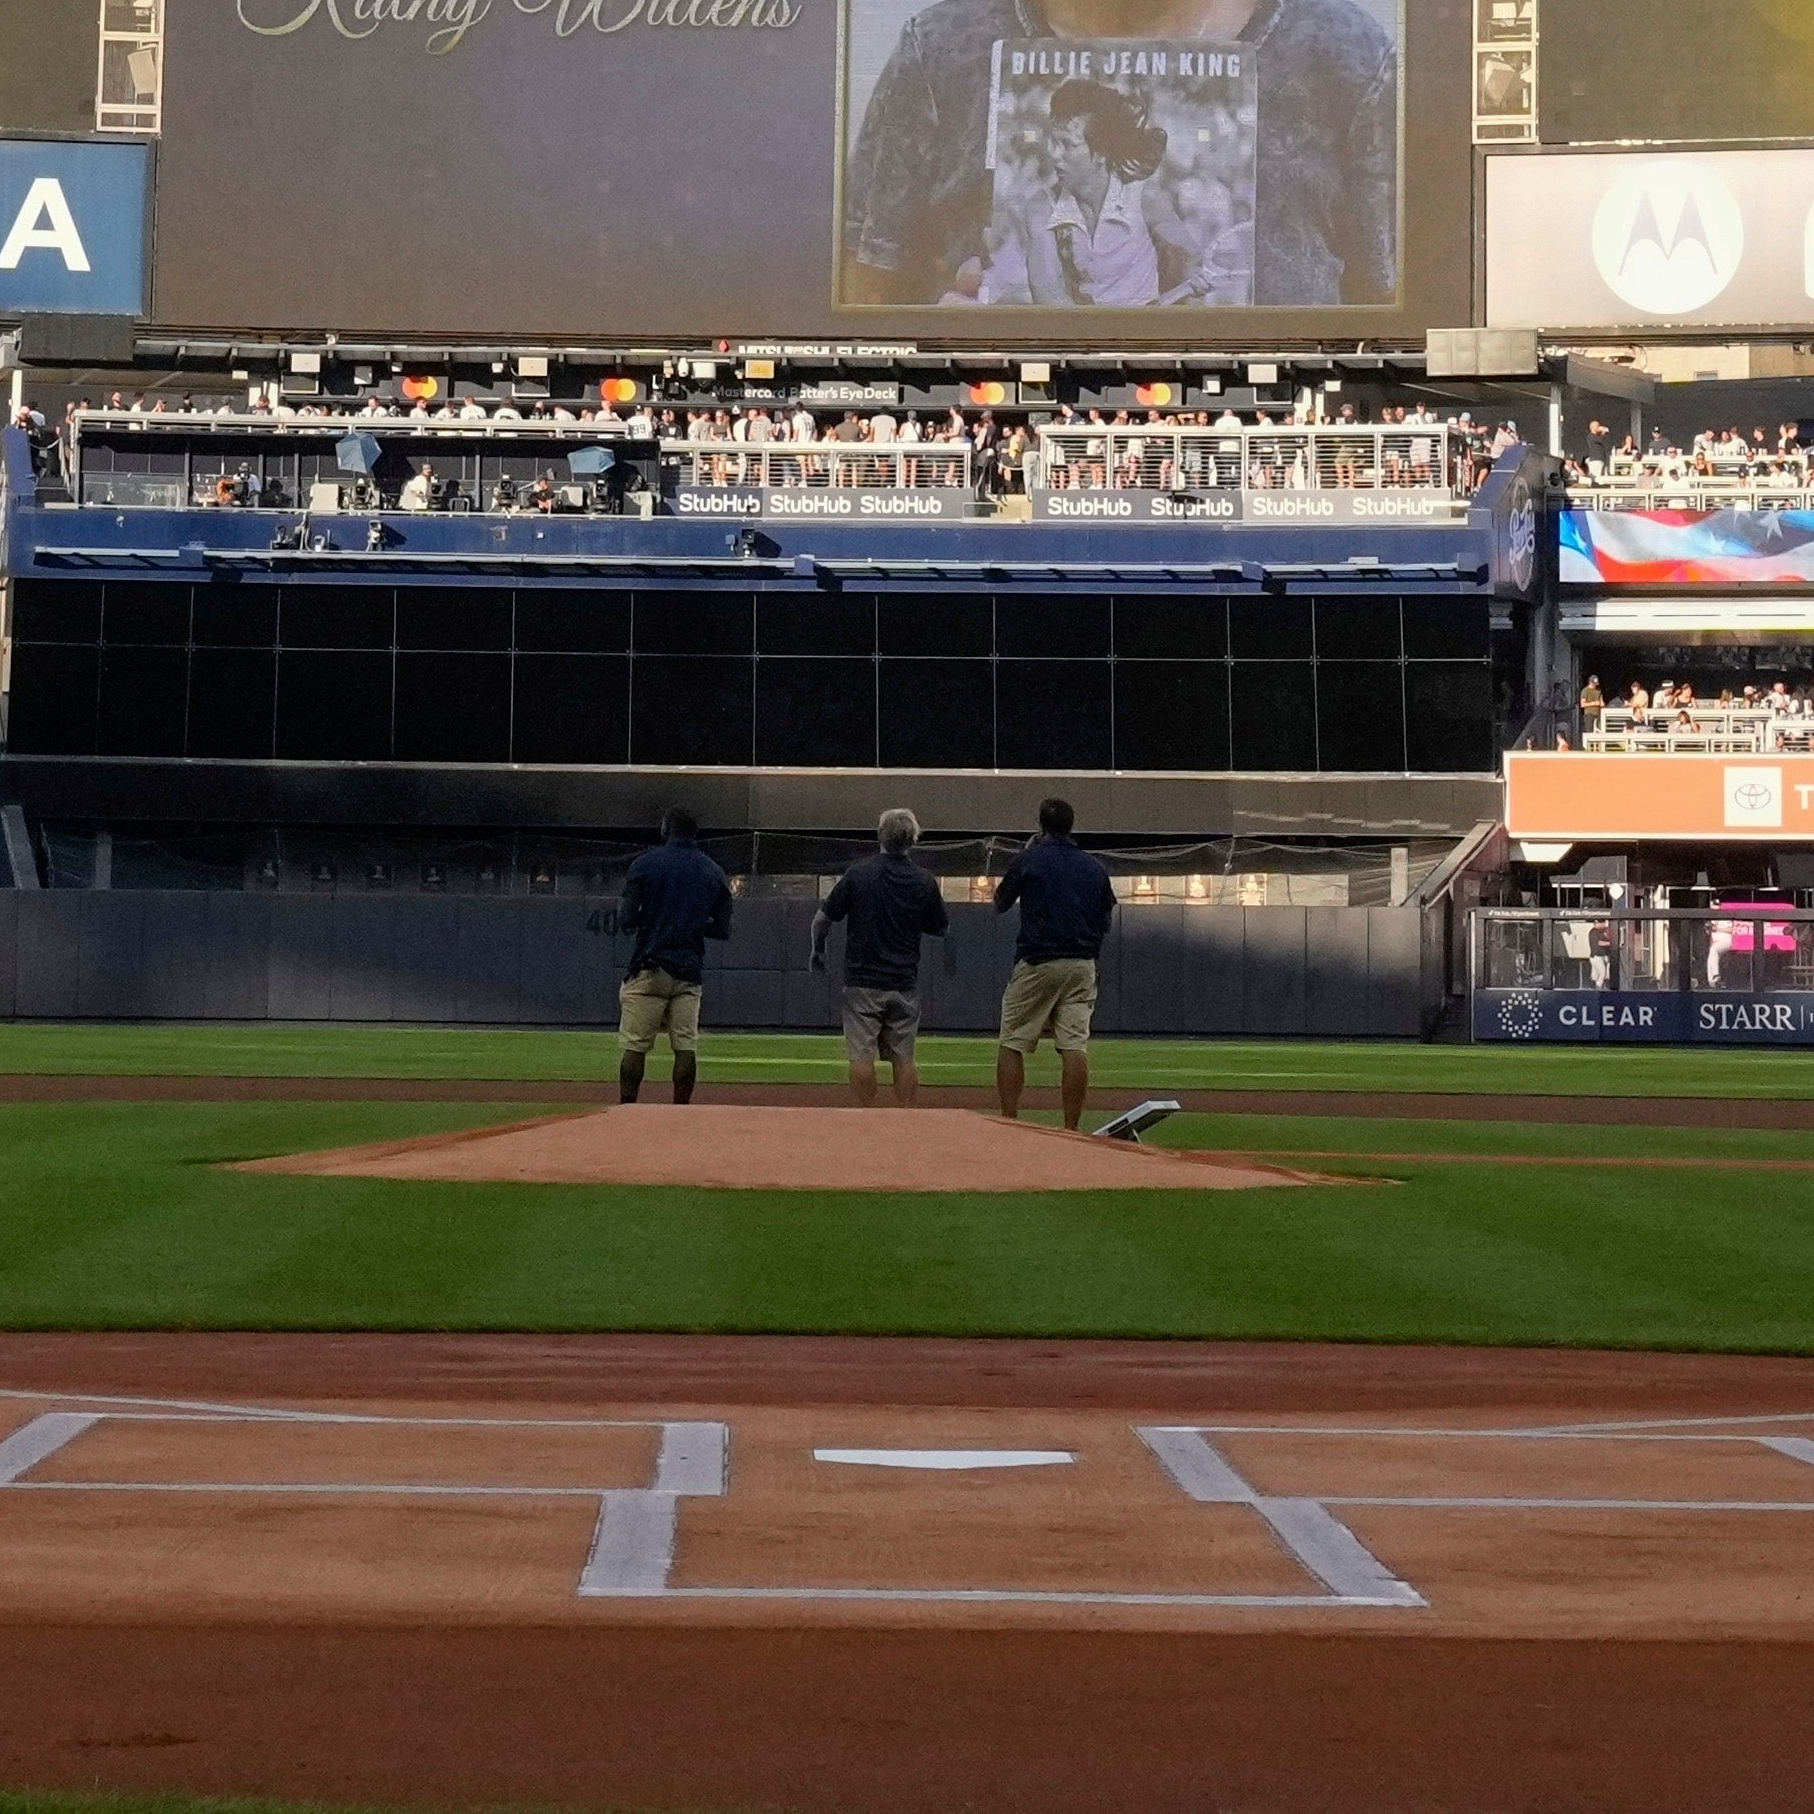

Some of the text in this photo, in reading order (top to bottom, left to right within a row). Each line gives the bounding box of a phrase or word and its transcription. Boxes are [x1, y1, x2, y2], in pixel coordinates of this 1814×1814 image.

[1011, 51, 1241, 78] BILLIE JEAN KING
[840, 387, 866, 402] Eye
[866, 388, 896, 400] Deck
[679, 493, 761, 513] StubHub
[770, 495, 852, 514] StubHub
[860, 496, 942, 515] StubHub
[1047, 496, 1132, 517] StubHub
[1150, 497, 1235, 518] StubHub
[1253, 497, 1334, 516] StubHub
[1352, 496, 1434, 516] StubHub
[1558, 1005, 1654, 1026] CLEAR
[1698, 1004, 1795, 1030] STARR
